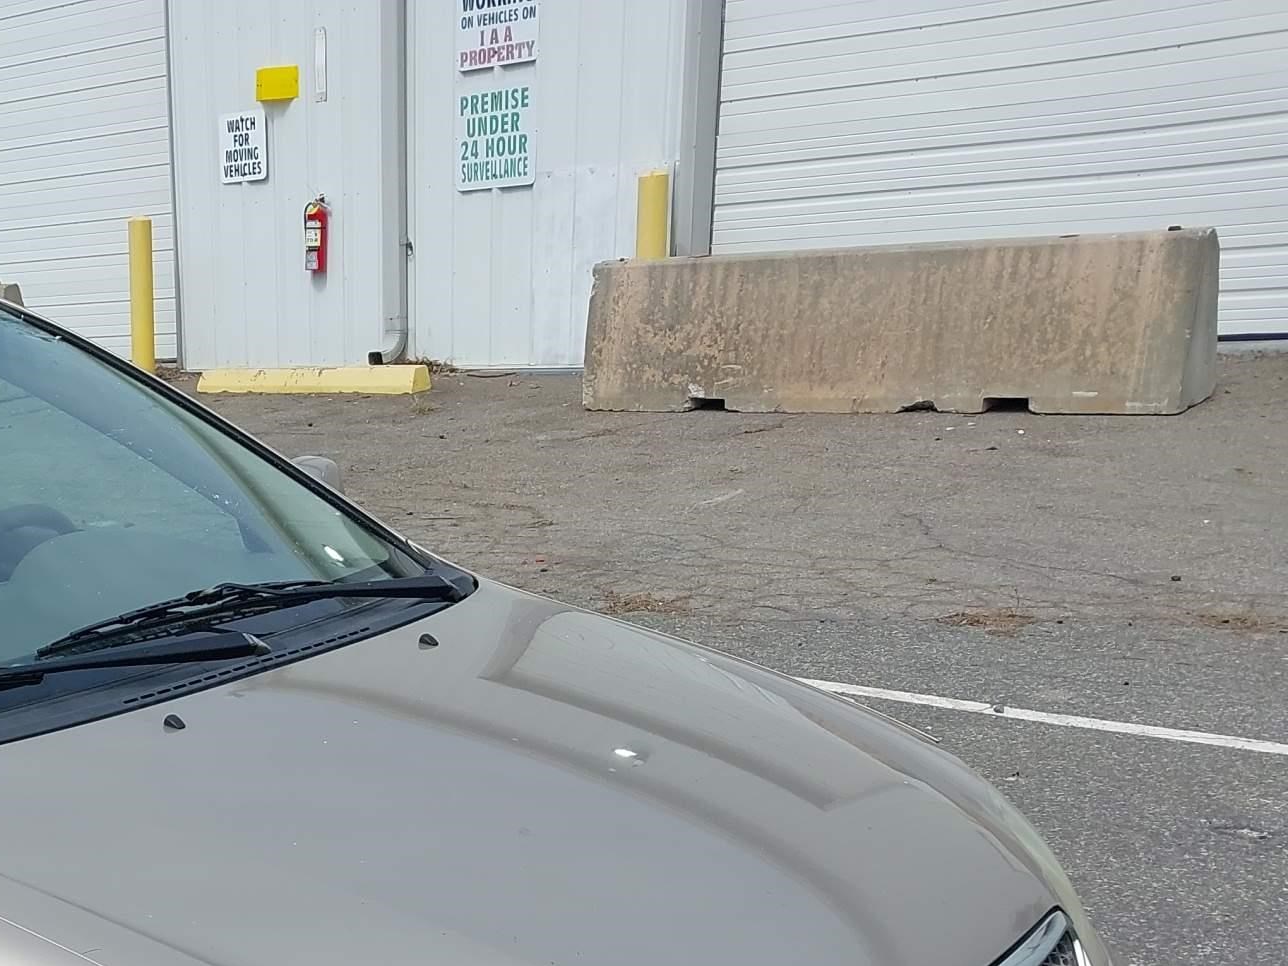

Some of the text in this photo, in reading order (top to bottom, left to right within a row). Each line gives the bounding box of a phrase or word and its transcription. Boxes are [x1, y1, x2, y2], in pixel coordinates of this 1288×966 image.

[461, 16, 474, 30] ON
[477, 8, 519, 27] VEHICLES
[522, 6, 537, 20] ON
[460, 40, 535, 68] PROPERTY
[460, 87, 529, 117] PREMISE
[226, 116, 256, 133] WATCH
[467, 112, 520, 138] UNDER
[233, 132, 250, 148] FOR
[461, 134, 528, 161] 24 HOUR
[225, 146, 259, 164] MOVING
[223, 161, 262, 178] VEHICLES
[461, 156, 528, 183] SURVEILLANCE
